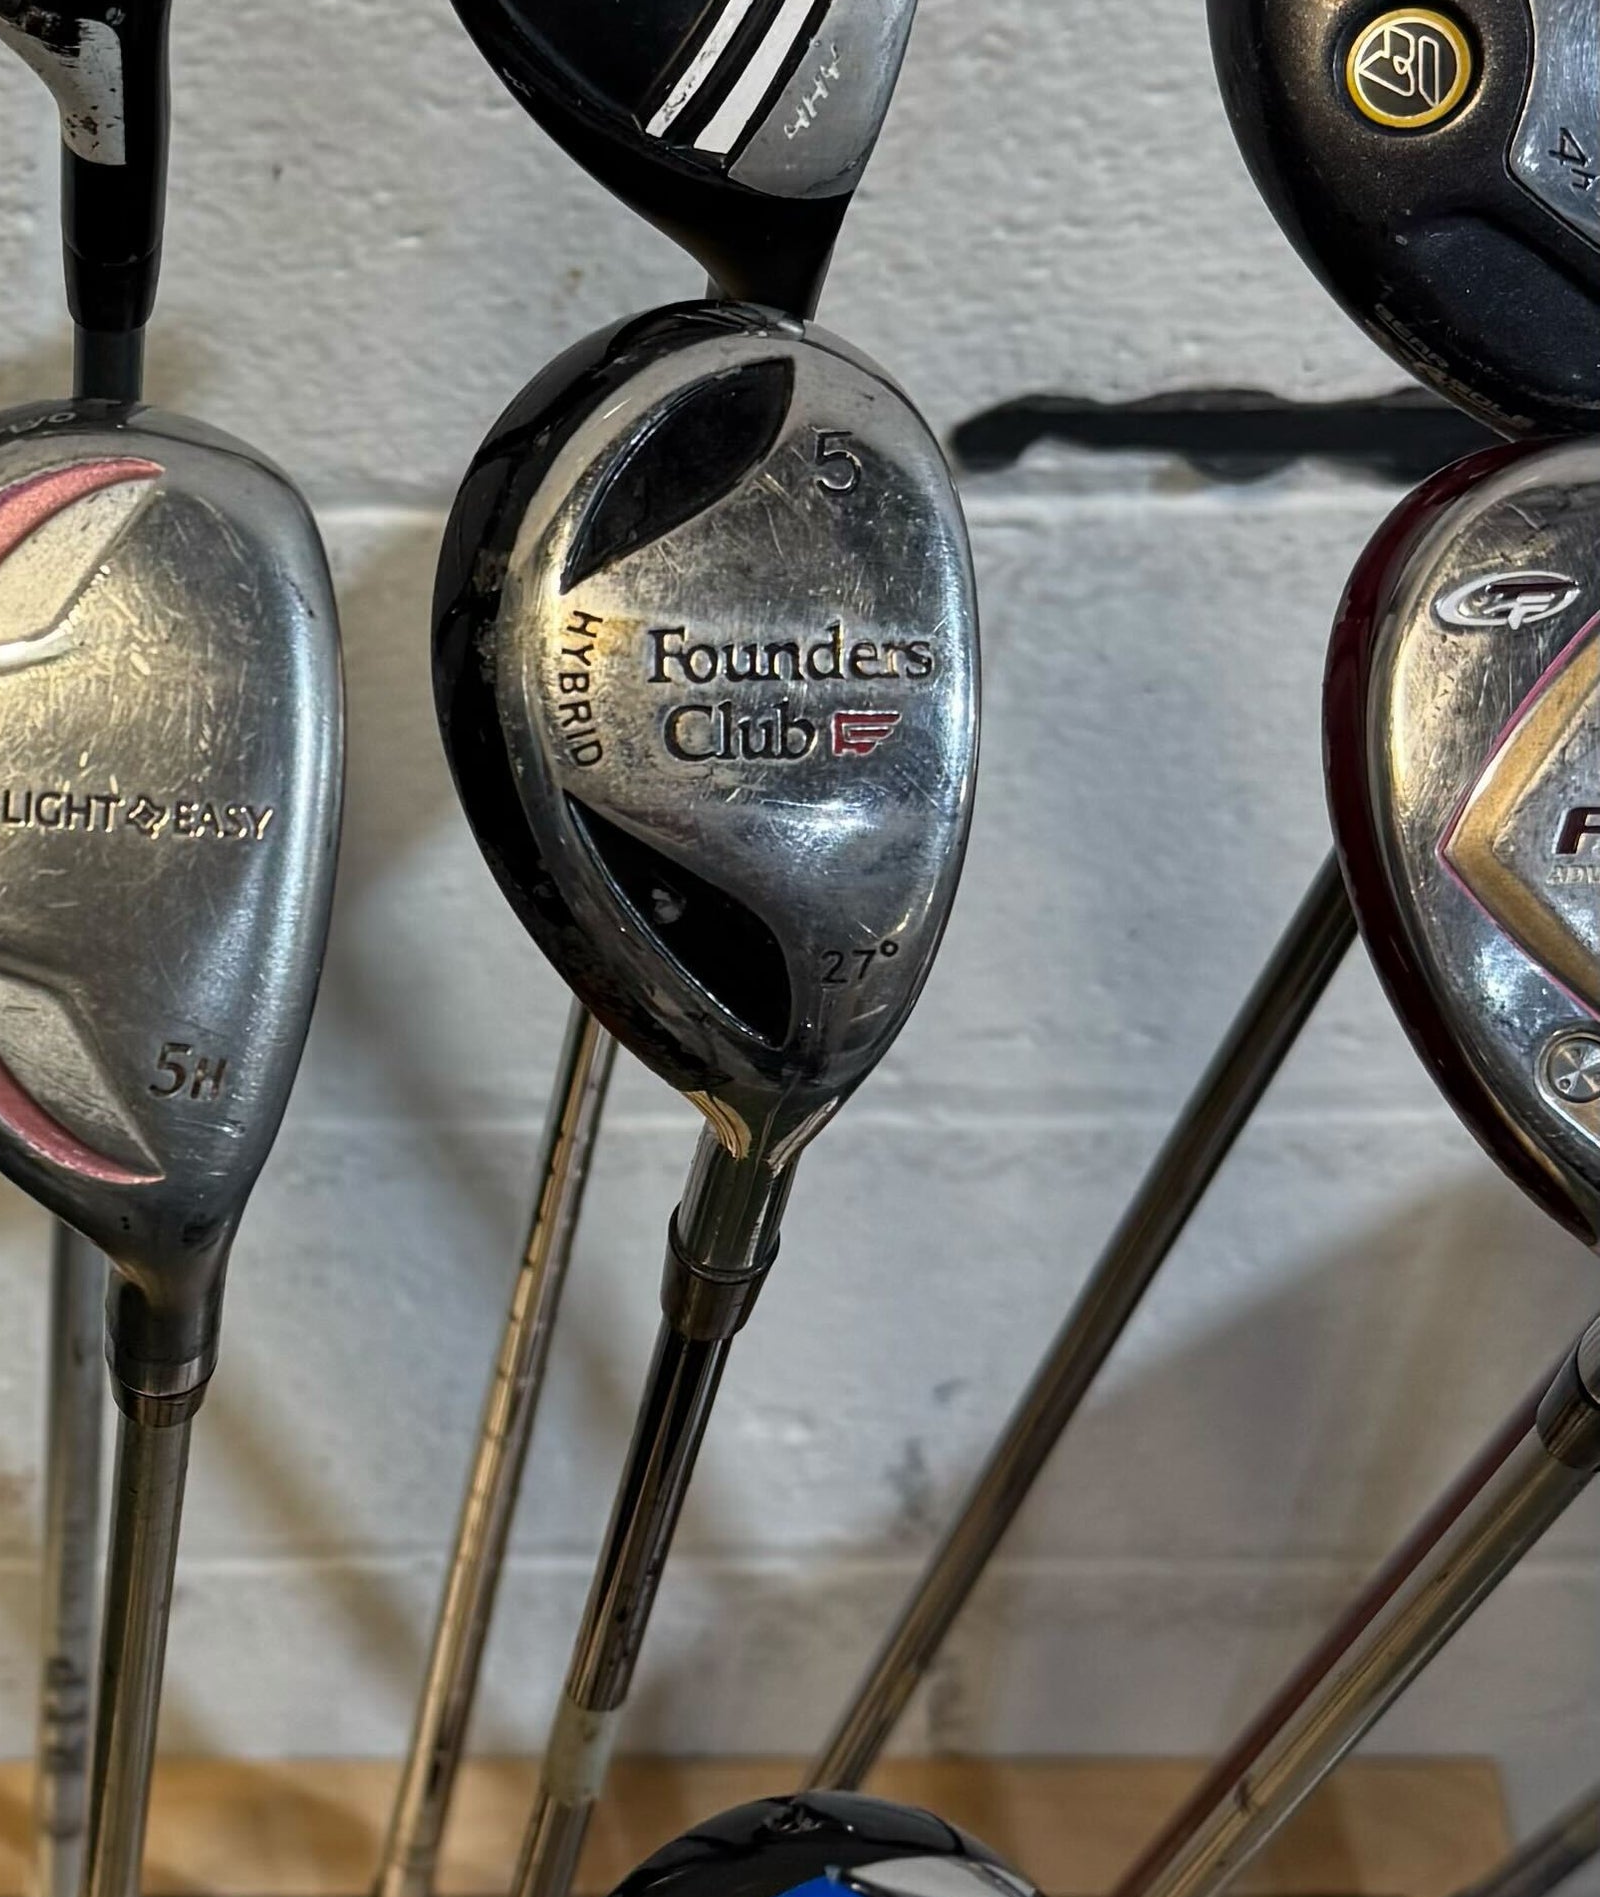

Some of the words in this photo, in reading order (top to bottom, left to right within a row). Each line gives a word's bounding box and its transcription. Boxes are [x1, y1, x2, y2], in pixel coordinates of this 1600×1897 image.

[814, 429, 863, 497] 5
[647, 619, 934, 685] Founders
[557, 609, 604, 768] HYBRID
[662, 699, 818, 762] Club
[2, 789, 123, 834] LIGHT
[173, 800, 274, 841] EASY
[148, 1042, 228, 1100] 5H
